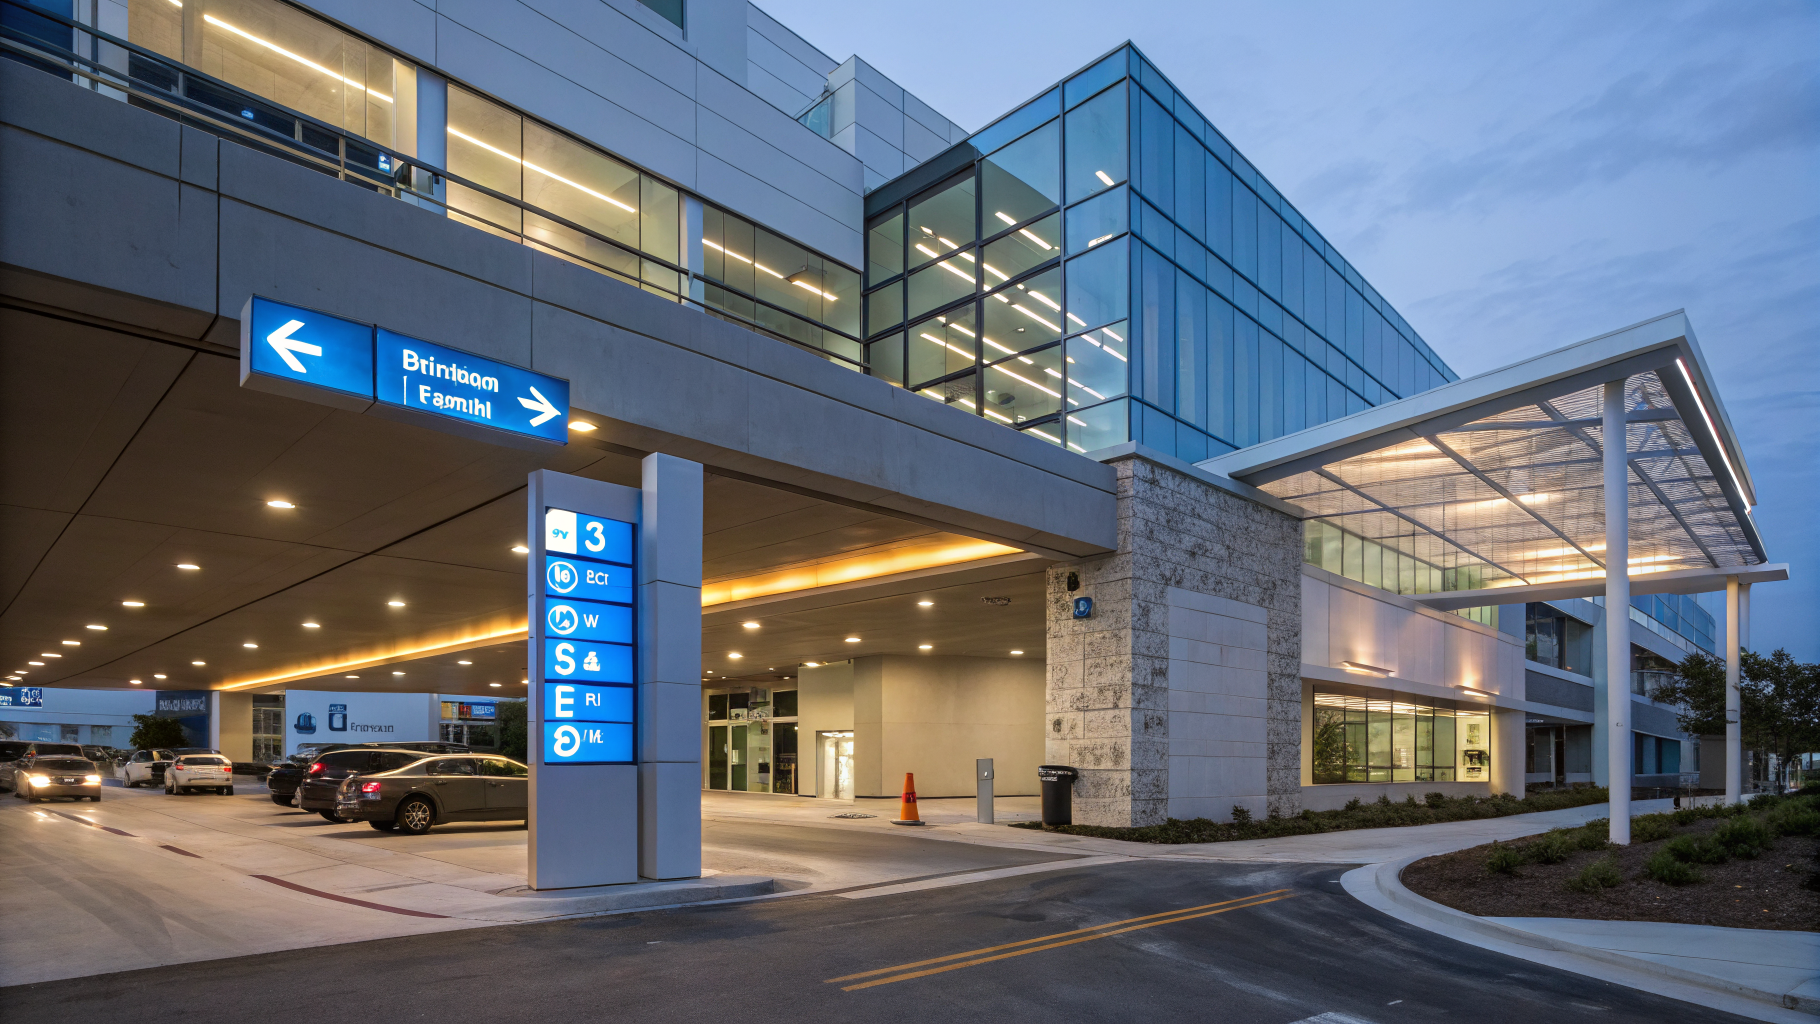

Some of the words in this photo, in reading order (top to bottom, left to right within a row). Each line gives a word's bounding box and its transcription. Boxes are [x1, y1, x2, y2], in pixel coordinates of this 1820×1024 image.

[584, 521, 606, 552] 3
[583, 613, 599, 628] W
[554, 642, 576, 676] S
[555, 685, 575, 718] E
